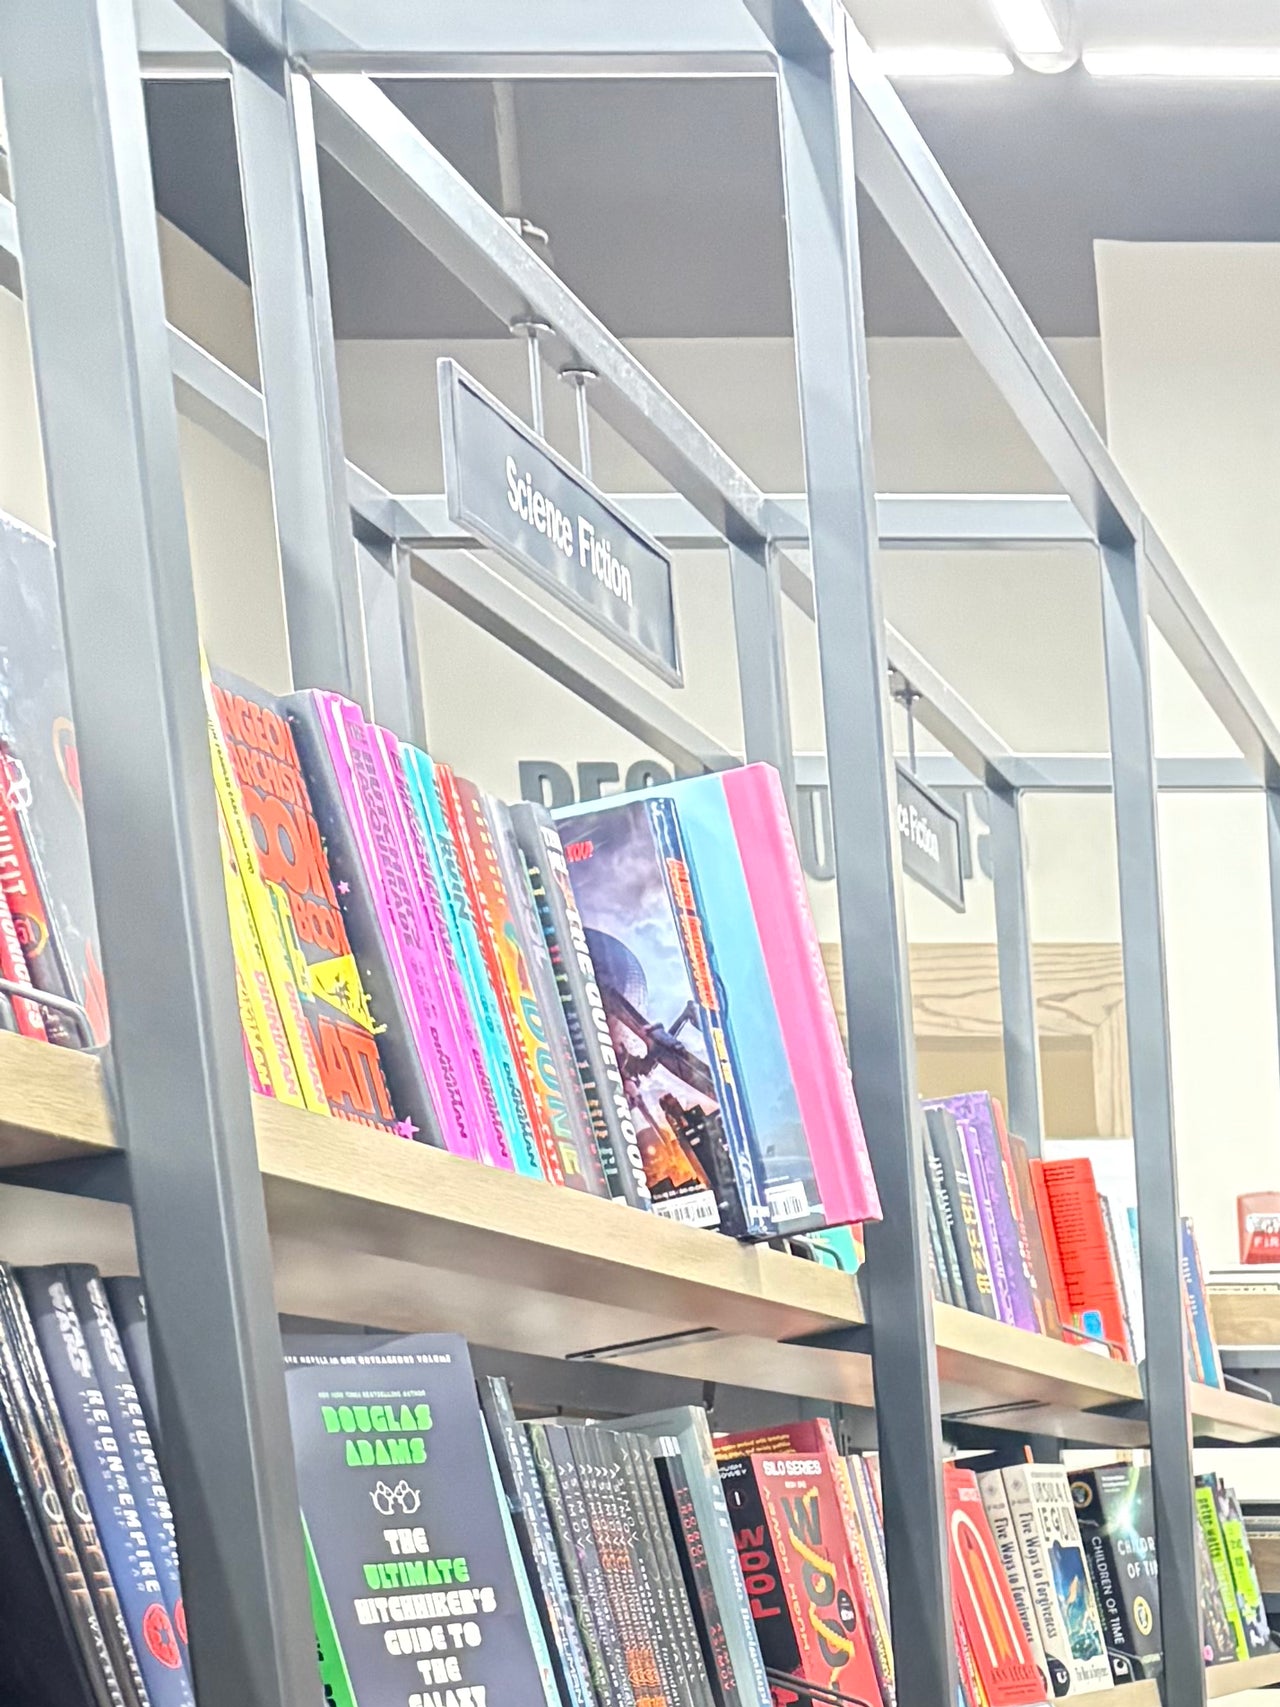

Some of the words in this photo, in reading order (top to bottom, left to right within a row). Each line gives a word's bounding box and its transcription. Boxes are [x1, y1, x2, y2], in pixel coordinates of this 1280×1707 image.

[506, 455, 573, 558] Science
[577, 515, 633, 608] Fiction
[321, 1404, 433, 1434] DOUGLAS
[345, 1437, 427, 1467] ADAMS
[383, 1527, 430, 1554] THE
[363, 1558, 470, 1590] ULTIMATE
[1091, 1536, 1113, 1600] CHILDREN
[353, 1587, 497, 1625] HITCHHIKER'S
[1106, 1600, 1117, 1614] OF
[383, 1625, 448, 1655] GUIDE
[446, 1622, 482, 1648] TO
[1109, 1612, 1125, 1645] TIME
[416, 1656, 463, 1685] THE
